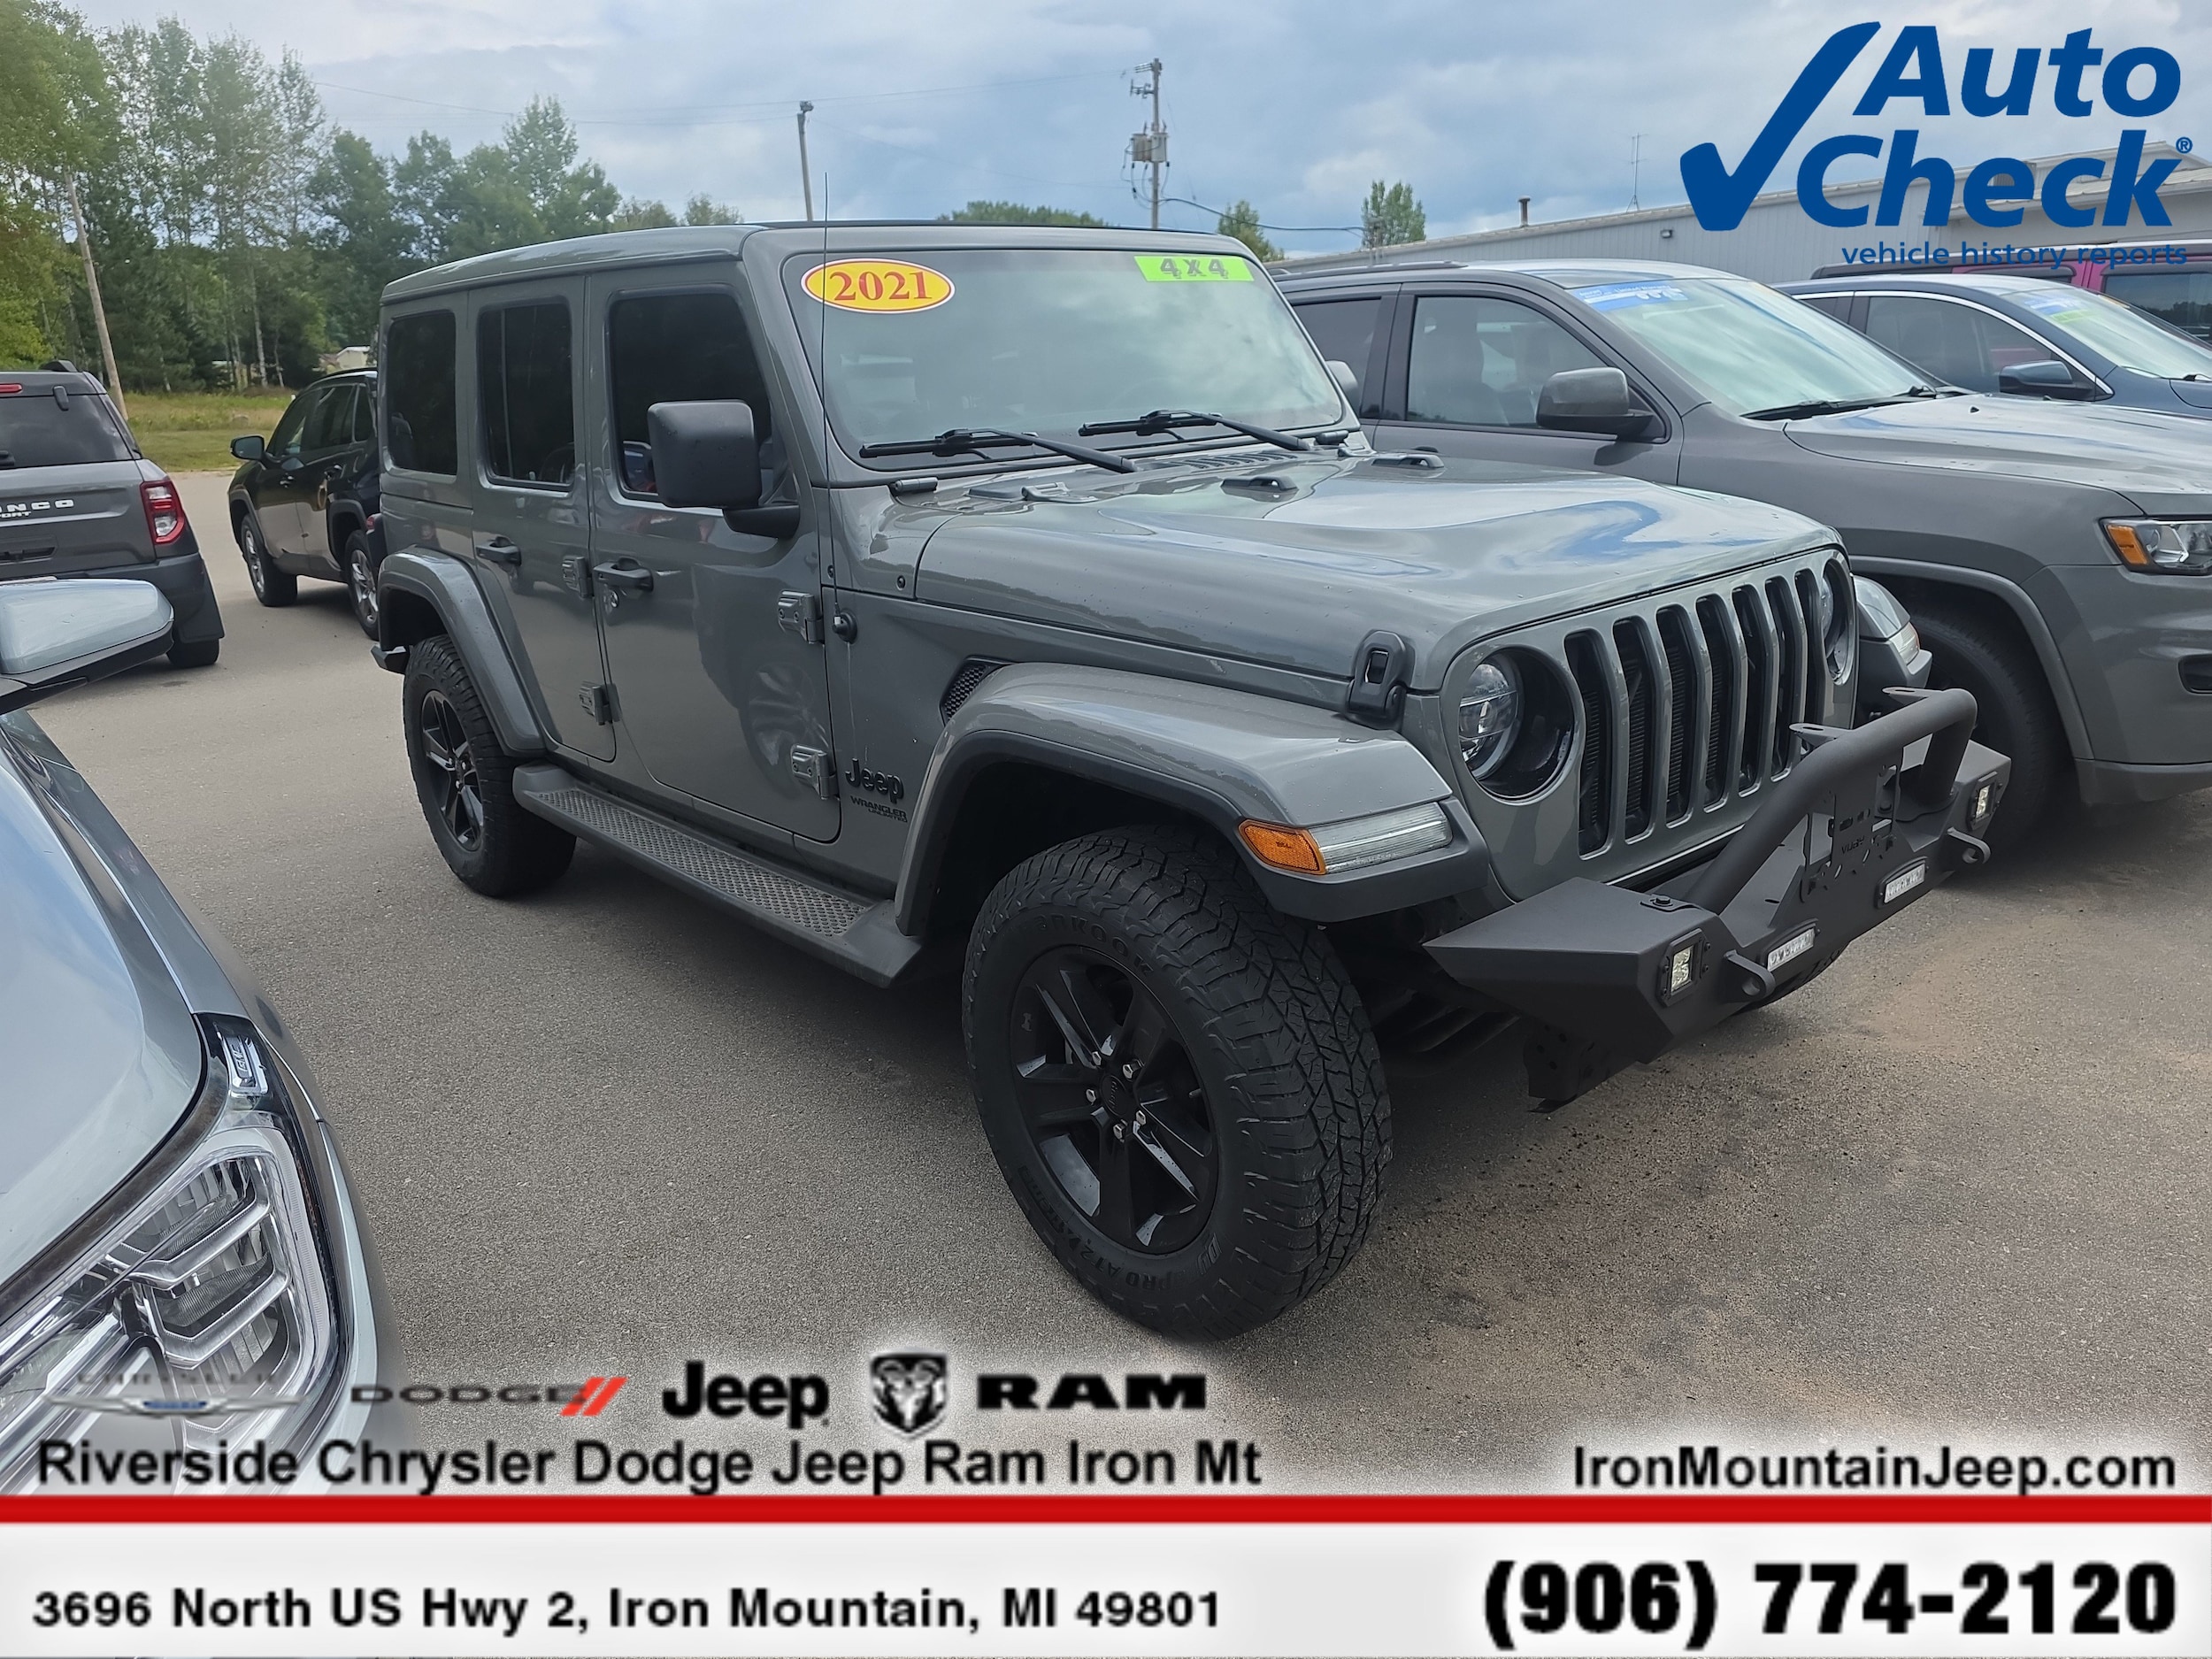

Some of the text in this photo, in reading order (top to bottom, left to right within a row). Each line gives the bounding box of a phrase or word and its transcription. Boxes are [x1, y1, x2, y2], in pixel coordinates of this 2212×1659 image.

[830, 271, 932, 301] 2021
[0, 499, 74, 513] NCO
[845, 757, 904, 804] Jeep
[849, 795, 907, 818] WRANGLER
